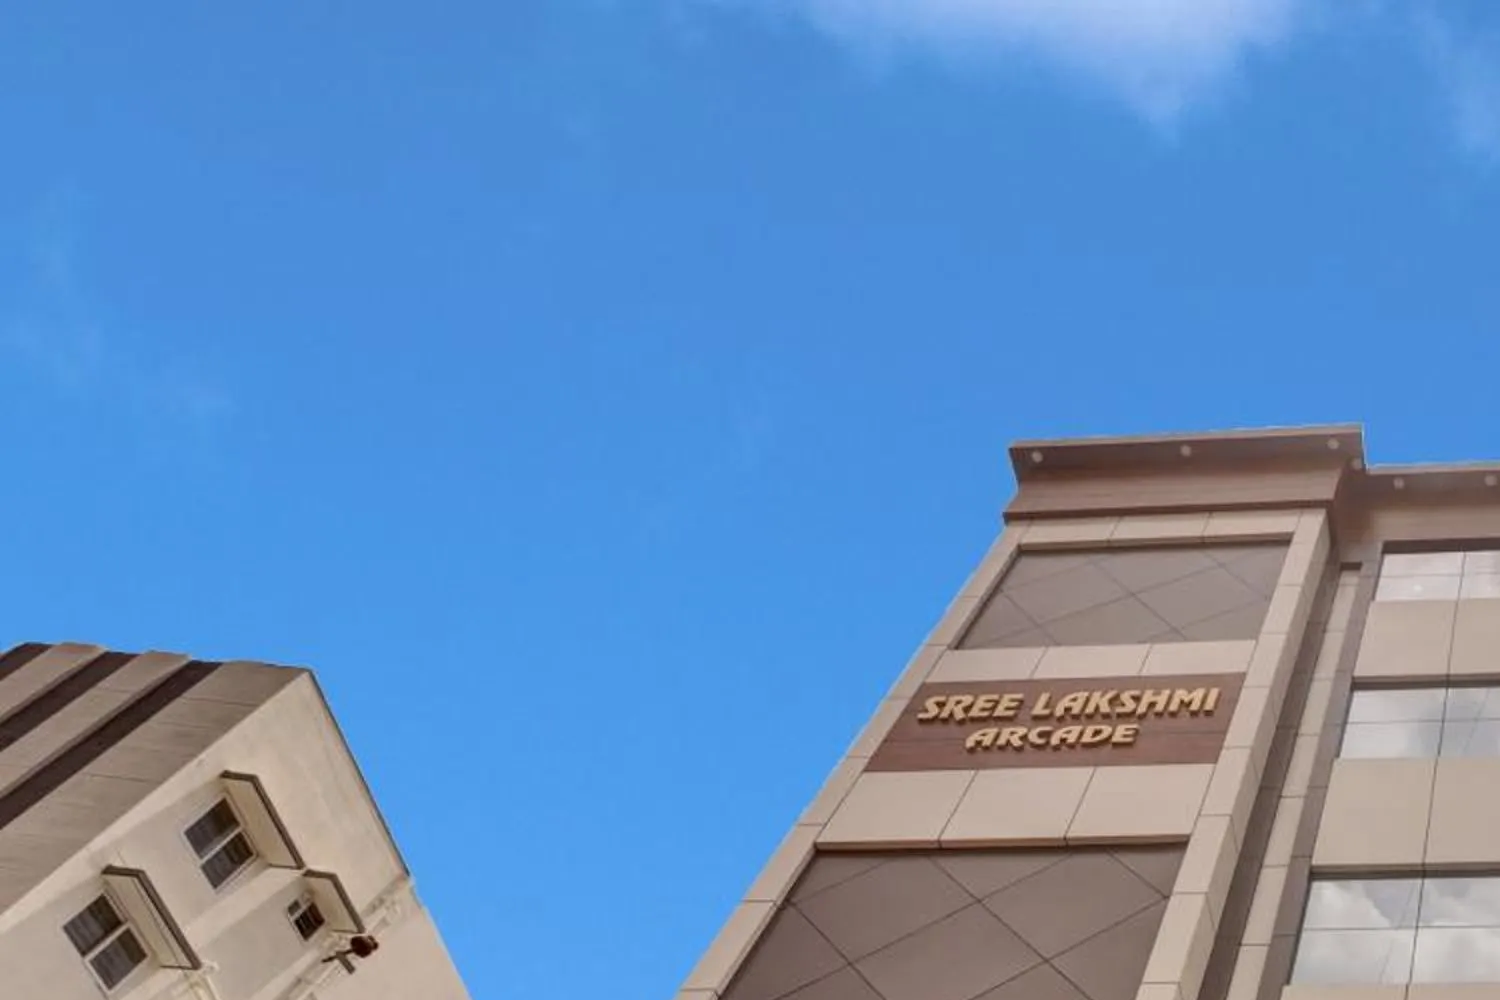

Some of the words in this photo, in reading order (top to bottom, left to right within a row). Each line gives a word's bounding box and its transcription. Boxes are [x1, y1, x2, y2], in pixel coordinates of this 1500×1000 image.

[917, 693, 1023, 724] SREE
[1031, 687, 1220, 718] LAKSHMI
[965, 724, 1140, 753] ARCADE
